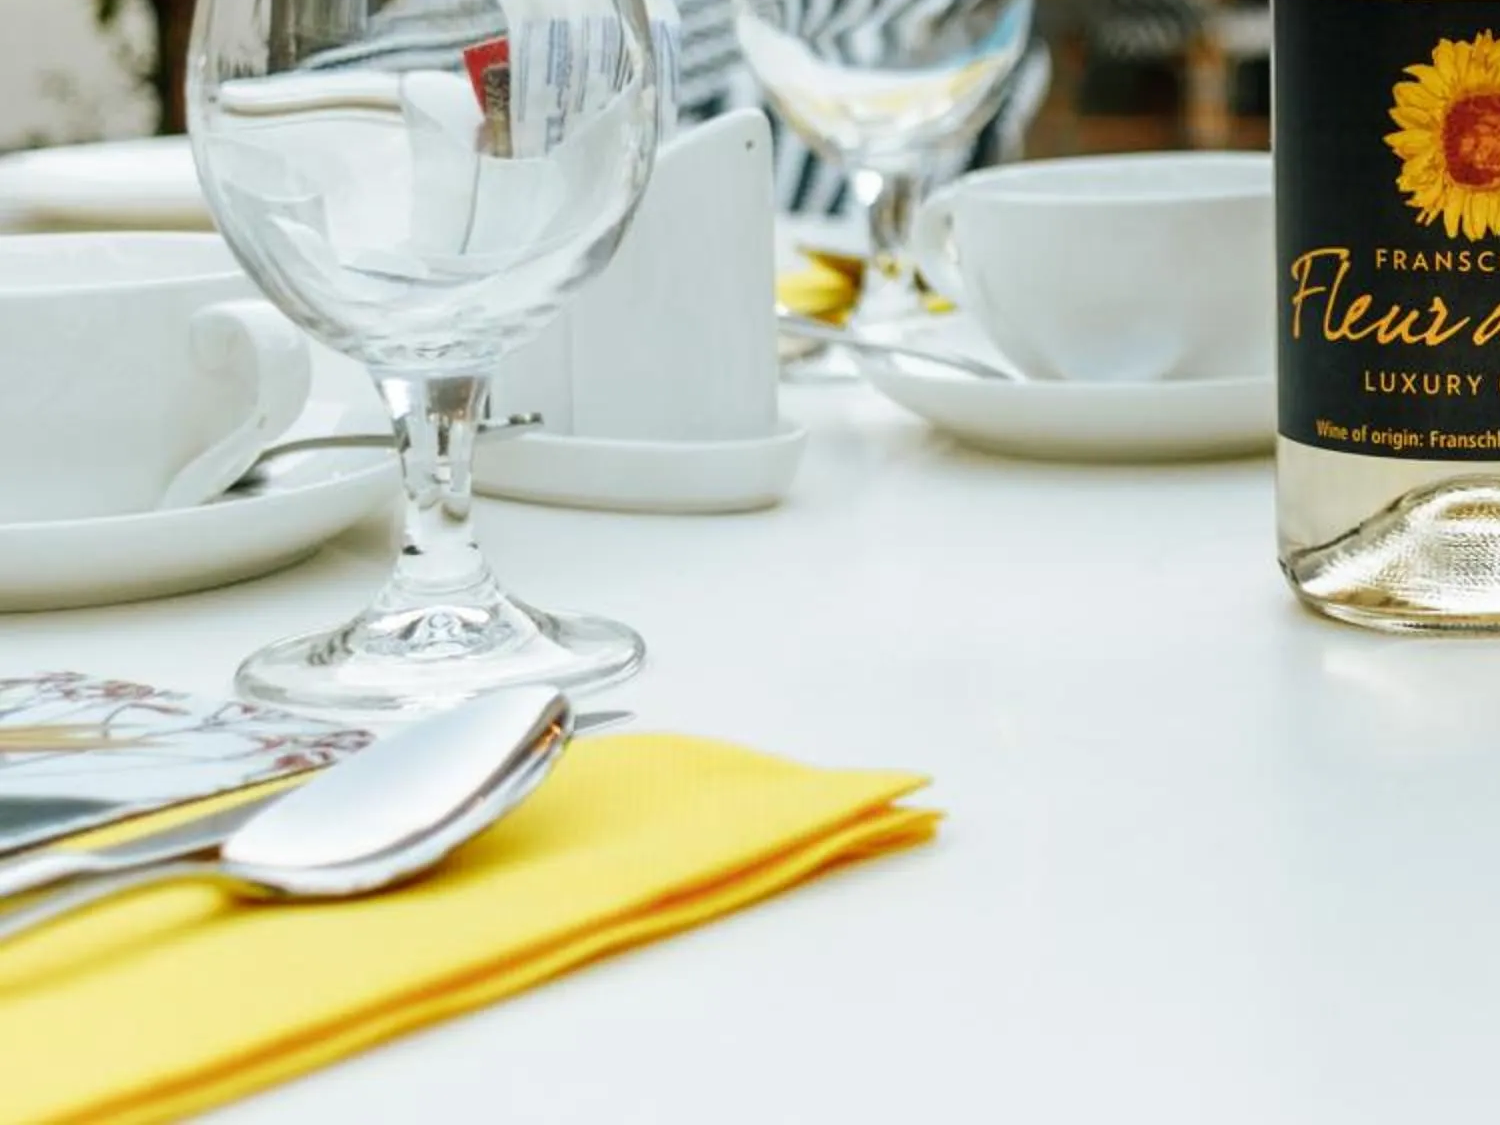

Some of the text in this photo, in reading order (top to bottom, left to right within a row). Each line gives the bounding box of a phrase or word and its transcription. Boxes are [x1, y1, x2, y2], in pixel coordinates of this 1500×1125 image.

[1291, 247, 1471, 346] Fleur
[1365, 371, 1482, 395] LUXURY
[1316, 419, 1348, 441] Wine
[1352, 425, 1367, 443] of
[1372, 428, 1424, 450] origin:
